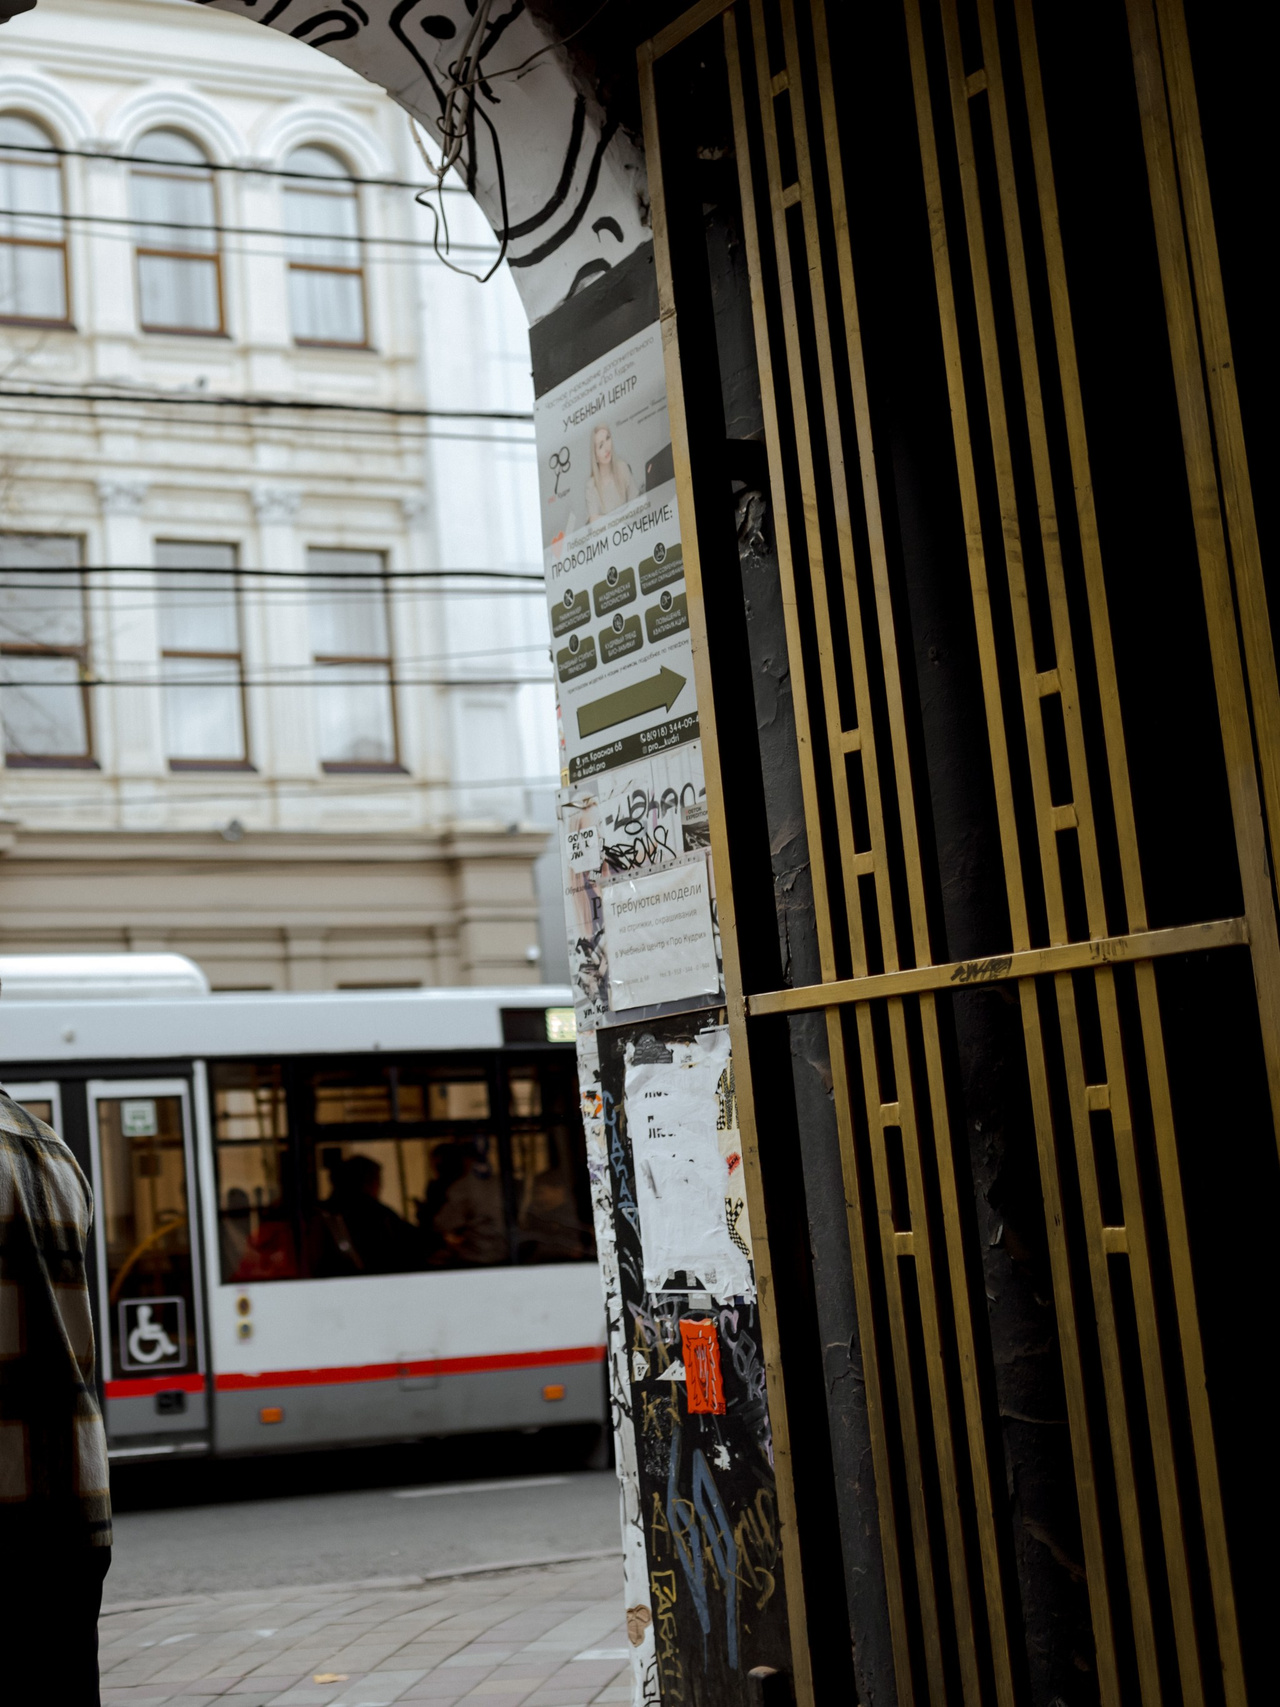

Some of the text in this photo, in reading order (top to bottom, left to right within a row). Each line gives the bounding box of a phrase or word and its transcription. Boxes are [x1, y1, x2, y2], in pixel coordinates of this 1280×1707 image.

[562, 392, 607, 432] УЧЕБНЫЙ
[608, 375, 638, 404] ЦЕНТР
[551, 504, 673, 580] ПРОВОДИМ ОБУЧЕНИЕ:
[646, 725, 668, 742] 8(918)
[590, 746, 614, 762] Красная
[610, 882, 702, 918] Требуются модели
[654, 908, 697, 926] окрашивания
[618, 943, 647, 958] Учебный
[646, 940, 666, 952] центр
[583, 1008, 595, 1019] ул.
